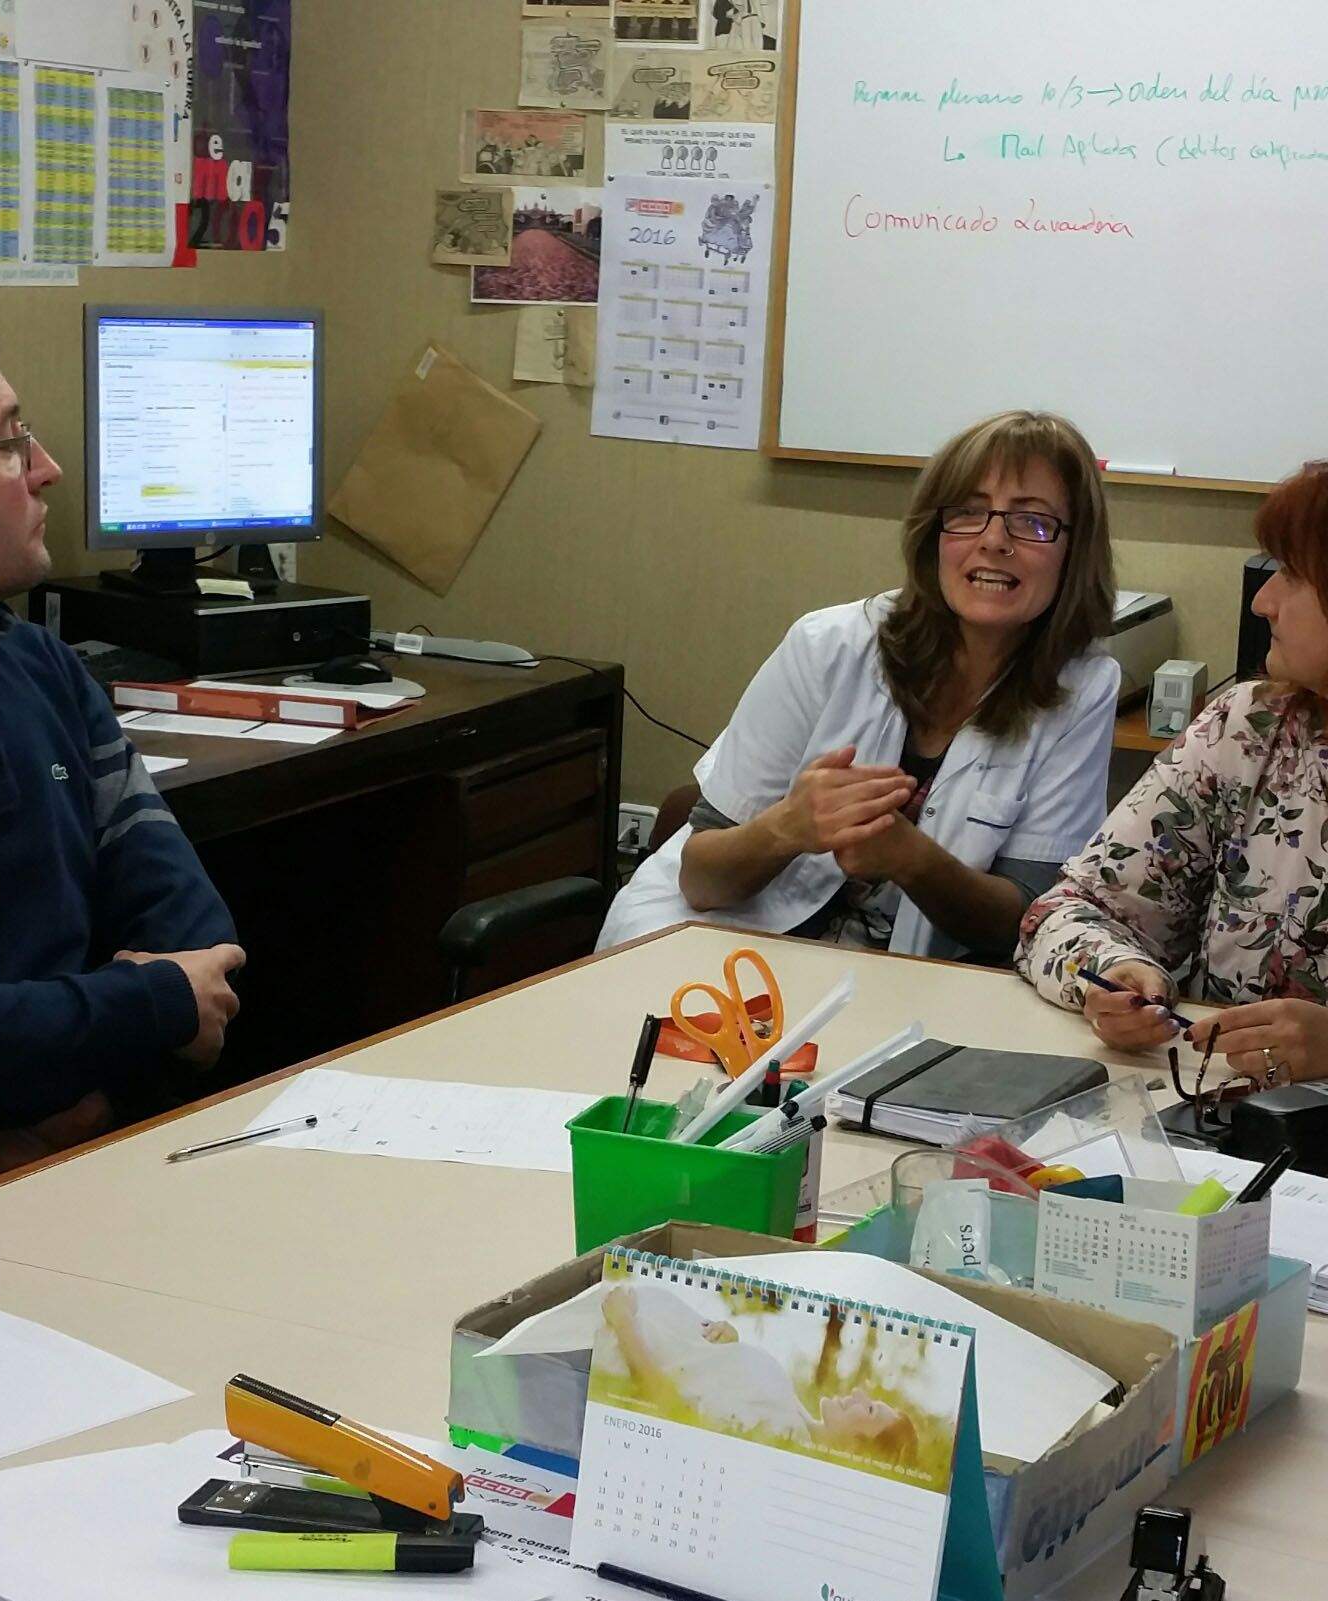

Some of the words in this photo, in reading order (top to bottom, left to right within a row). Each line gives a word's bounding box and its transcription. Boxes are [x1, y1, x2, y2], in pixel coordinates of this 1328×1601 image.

[1199, 73, 1232, 103] del
[629, 227, 677, 245] 2016
[960, 1224, 981, 1267] pers
[604, 1415, 636, 1431] ENERO
[638, 1423, 662, 1438] 2016
[473, 1467, 491, 1476] TU
[496, 1472, 527, 1483] AMB
[468, 1477, 527, 1500] CCOO
